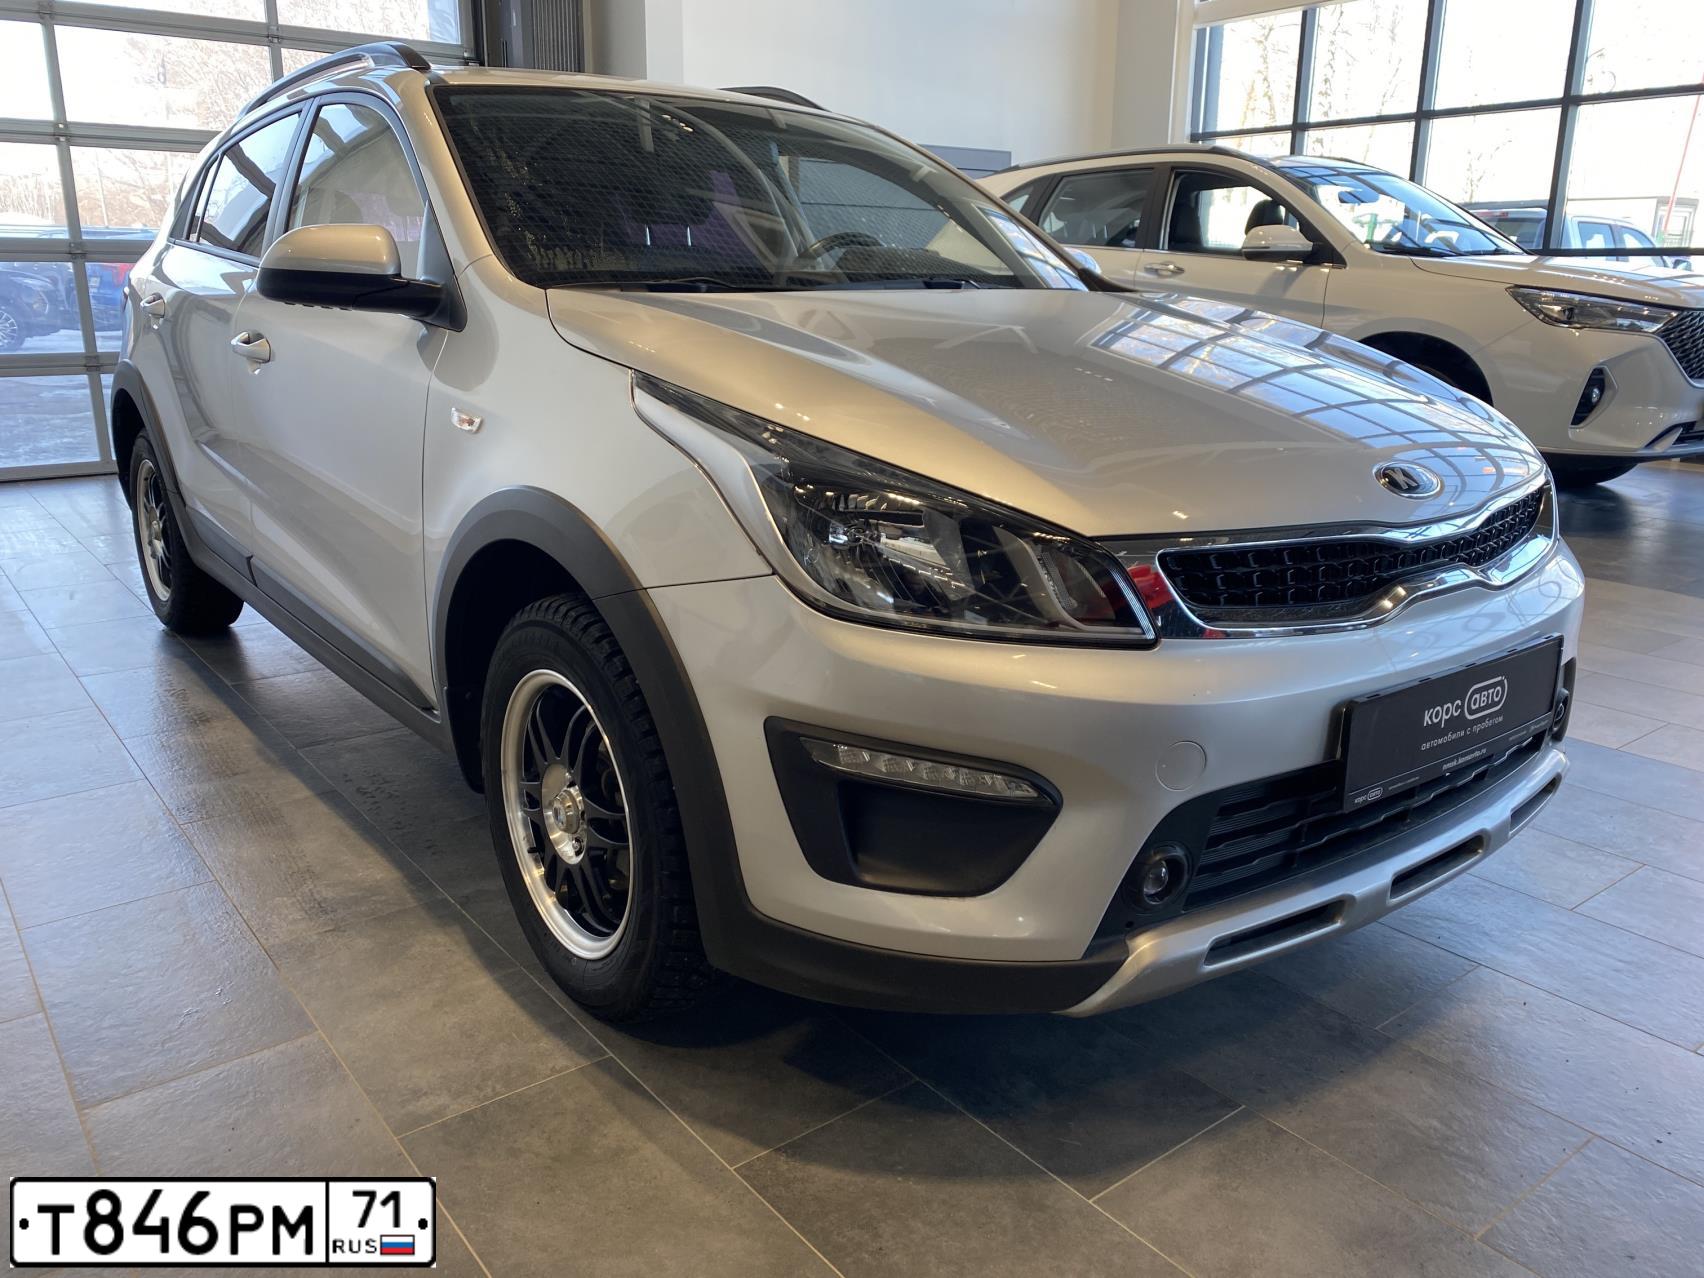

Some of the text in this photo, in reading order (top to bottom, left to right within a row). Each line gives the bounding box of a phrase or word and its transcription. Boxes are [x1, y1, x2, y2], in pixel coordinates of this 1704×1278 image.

[1423, 699, 1462, 729] корс
[1421, 731, 1465, 751] автомобили
[1472, 715, 1504, 733] пробегом
